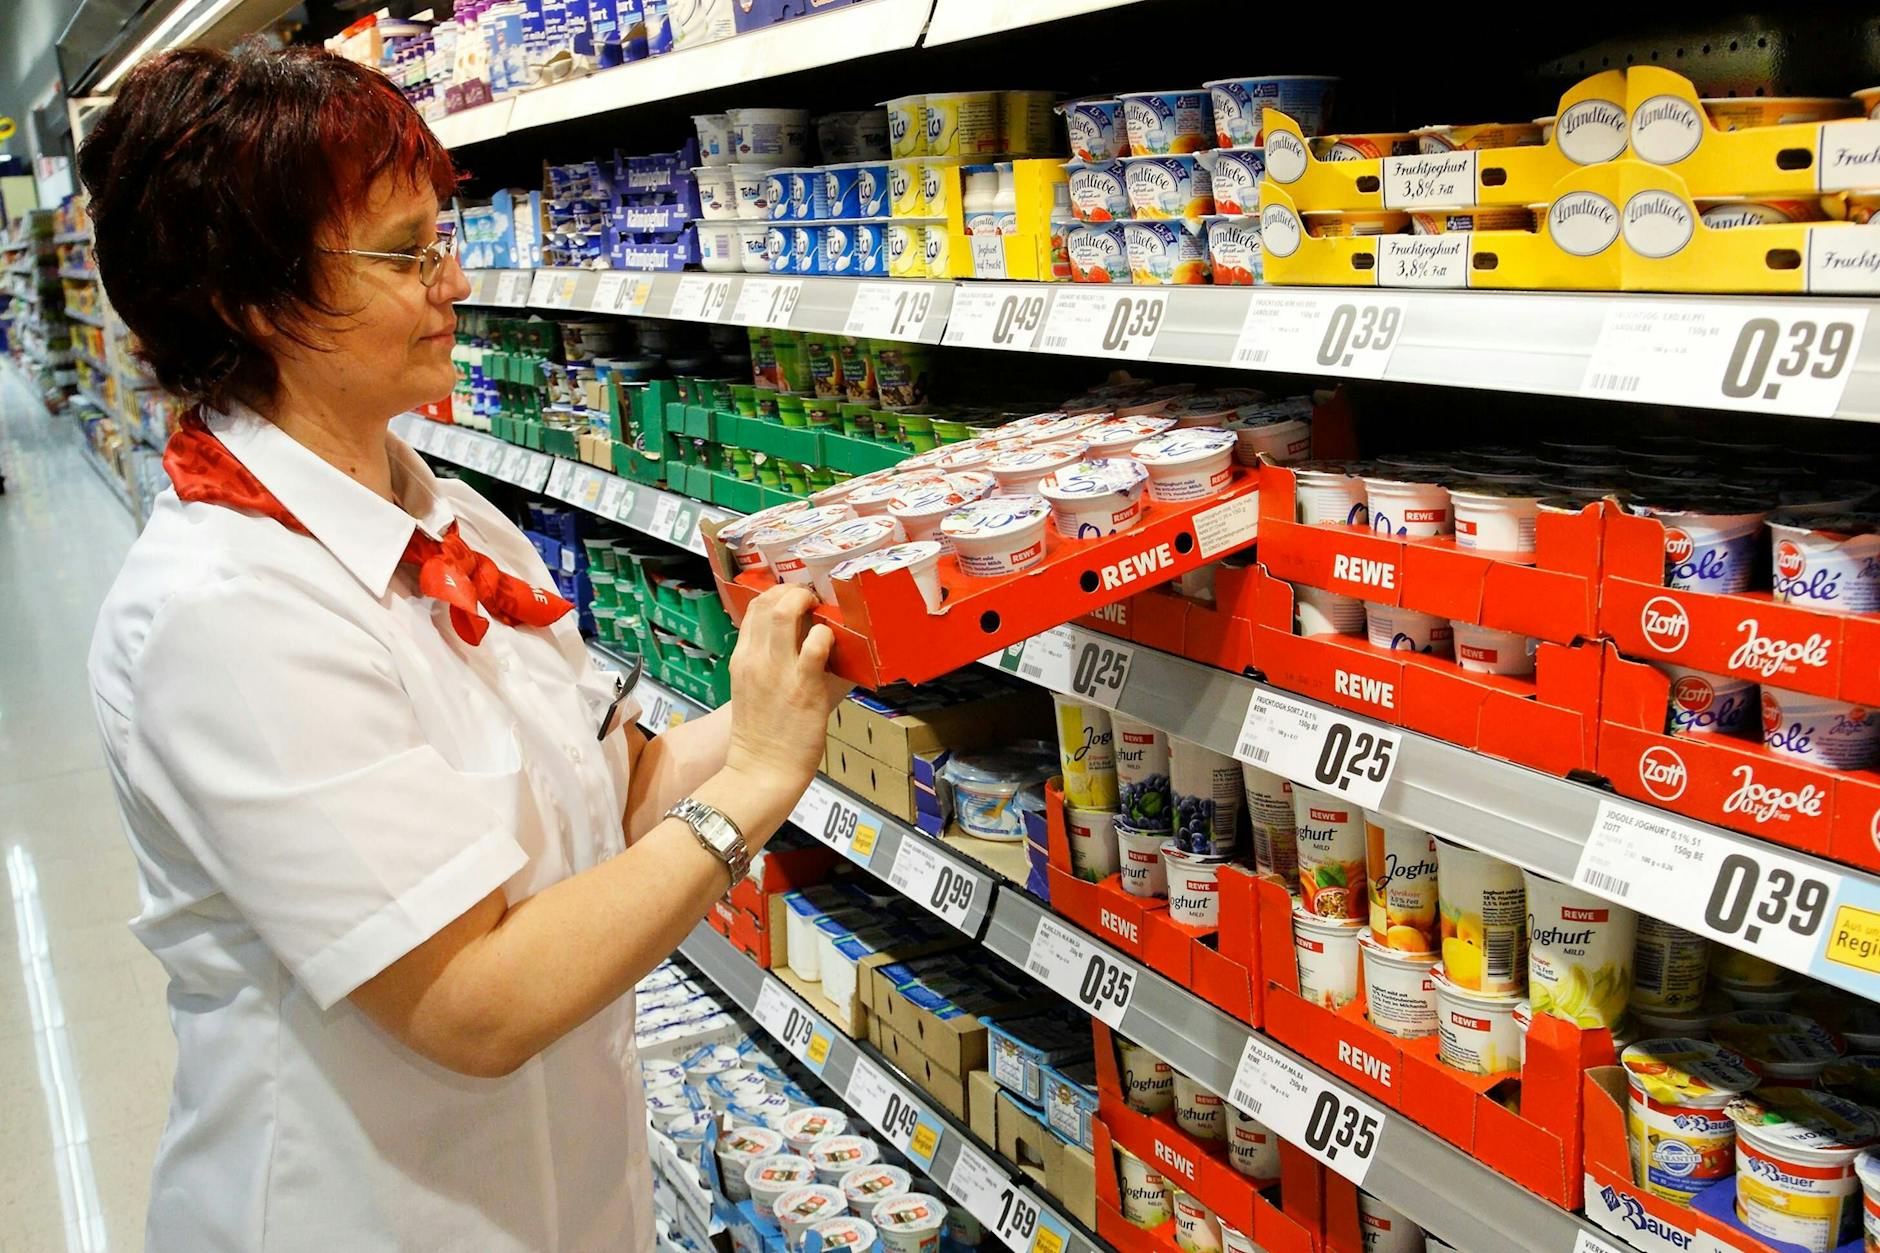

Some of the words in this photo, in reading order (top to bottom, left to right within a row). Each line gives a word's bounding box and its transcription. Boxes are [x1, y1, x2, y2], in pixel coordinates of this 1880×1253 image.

[1564, 105, 1626, 135] Landliebe
[1638, 102, 1696, 131] Landliebe
[1393, 158, 1469, 178] Fruchtjoghurt
[1402, 179, 1435, 200] 3,8%
[1556, 200, 1615, 225] Landliebe
[1630, 197, 1688, 226] Landliebe
[1390, 242, 1463, 263] Fruchtjoghurt
[1396, 260, 1428, 279] 3,8%
[700, 282, 729, 318] 1.19
[766, 284, 799, 323] 1.19
[890, 290, 932, 335] 1.19
[993, 294, 1044, 344] 0.49
[1102, 297, 1164, 352] 0.39
[1316, 303, 1401, 368] 0.39
[1721, 317, 1855, 400] 0.39
[1114, 507, 1135, 523] REWE
[1406, 511, 1434, 521] REWE
[1012, 547, 1035, 563] REWE
[1101, 543, 1174, 591] REWE
[1333, 554, 1395, 590] REWE
[1646, 610, 1687, 637] Zott
[1462, 647, 1485, 660] REWE
[1728, 619, 1832, 677] Jogolé
[1073, 642, 1128, 698] 0.25
[1334, 668, 1395, 710] REWE
[1677, 684, 1713, 702] Zott
[1314, 722, 1394, 791] 0.25
[1644, 758, 1684, 787] Zott
[1722, 765, 1826, 823] Jogolé
[823, 801, 858, 844] 0.59
[1312, 811, 1336, 821] REWE
[1602, 821, 1622, 833] ZOTT
[1606, 809, 1635, 826] JOGOLE
[1634, 819, 1670, 837] JOGHURT
[1673, 844, 1692, 860] 150g
[1693, 851, 1705, 862] BE
[930, 865, 973, 914] 0.99
[1188, 881, 1210, 891] REWE
[1376, 854, 1439, 892] Joghu
[1168, 893, 1212, 915] oghurt
[1563, 909, 1596, 921] REWE
[1704, 853, 1830, 944] 0.39
[1101, 908, 1138, 945] REWE
[1836, 930, 1880, 958] Regi
[1563, 947, 1586, 957] MILD
[1079, 954, 1132, 1012] 0.35
[782, 1007, 813, 1047] 0.79
[1453, 1014, 1479, 1029] REWE
[1337, 1039, 1392, 1088] REWE
[881, 1091, 918, 1138] 0.49
[1304, 1090, 1378, 1161] 0.35
[1154, 1139, 1195, 1182] REWE
[1760, 1161, 1815, 1188] Bauer
[996, 1188, 1037, 1239] 1.69
[1619, 1191, 1692, 1250] Bauer
